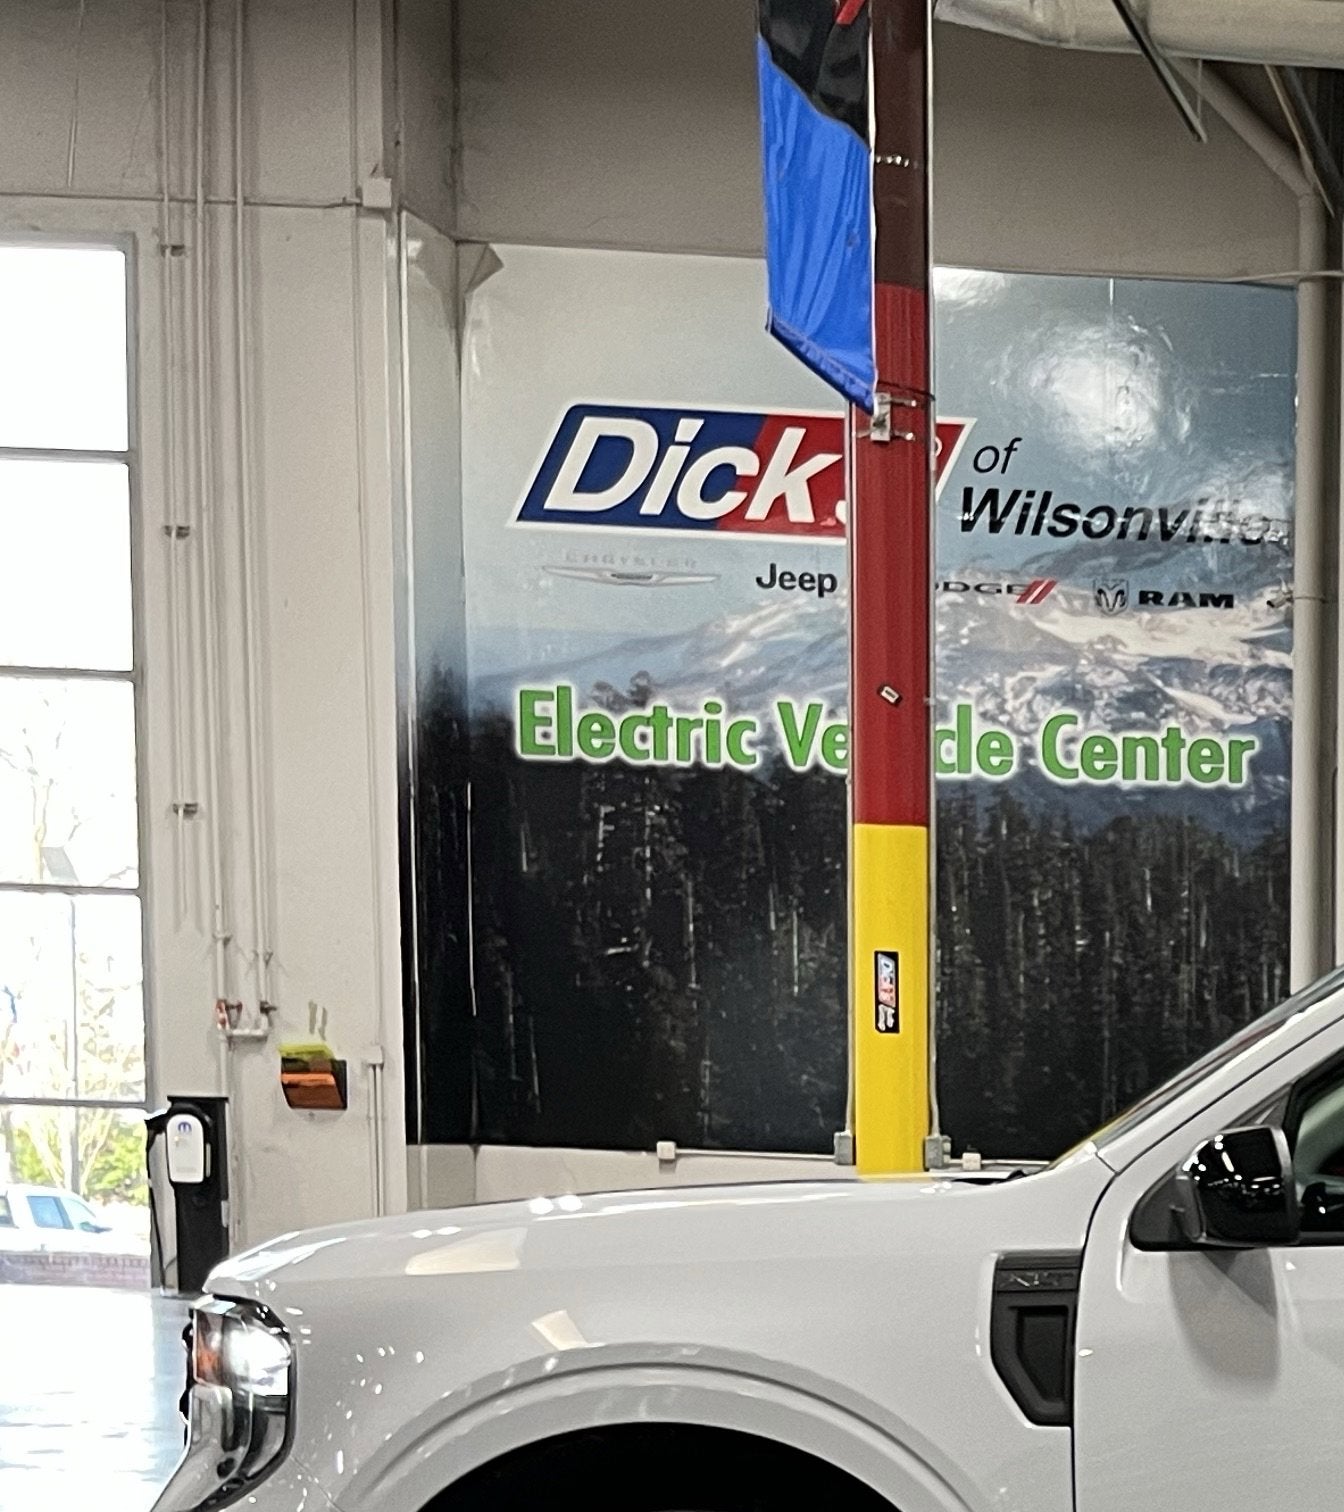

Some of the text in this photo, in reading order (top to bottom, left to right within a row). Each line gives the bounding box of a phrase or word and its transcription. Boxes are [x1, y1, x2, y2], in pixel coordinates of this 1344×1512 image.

[543, 415, 847, 525] Dick
[973, 437, 1023, 475] of
[756, 562, 838, 597] Jeep
[1138, 589, 1235, 609] RAM
[519, 685, 1256, 784] Electric Vecle Center
